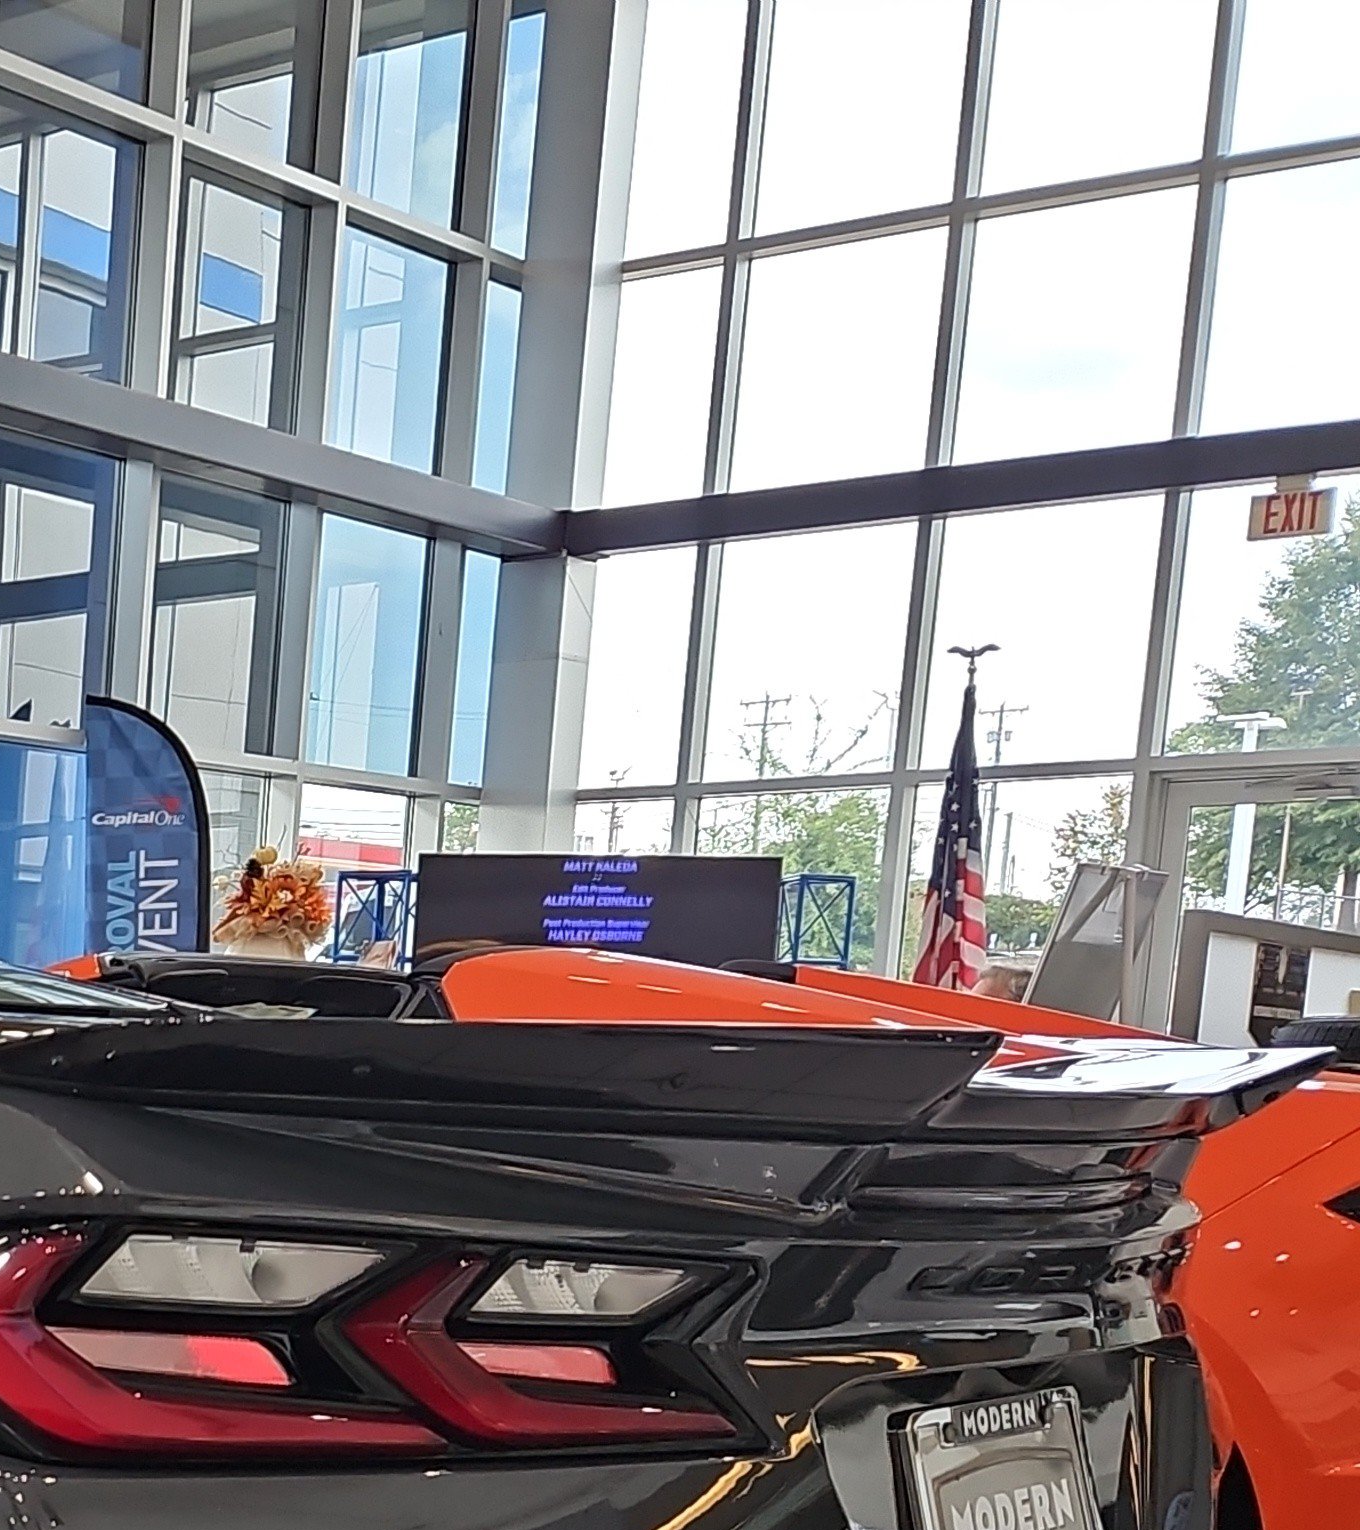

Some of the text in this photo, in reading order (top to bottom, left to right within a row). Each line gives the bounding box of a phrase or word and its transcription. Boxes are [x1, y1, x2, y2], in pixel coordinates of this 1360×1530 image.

[1263, 491, 1324, 534] EXIT
[563, 860, 594, 872] MATT
[548, 930, 592, 941] HAYLEY
[960, 1399, 1037, 1438] MODERN
